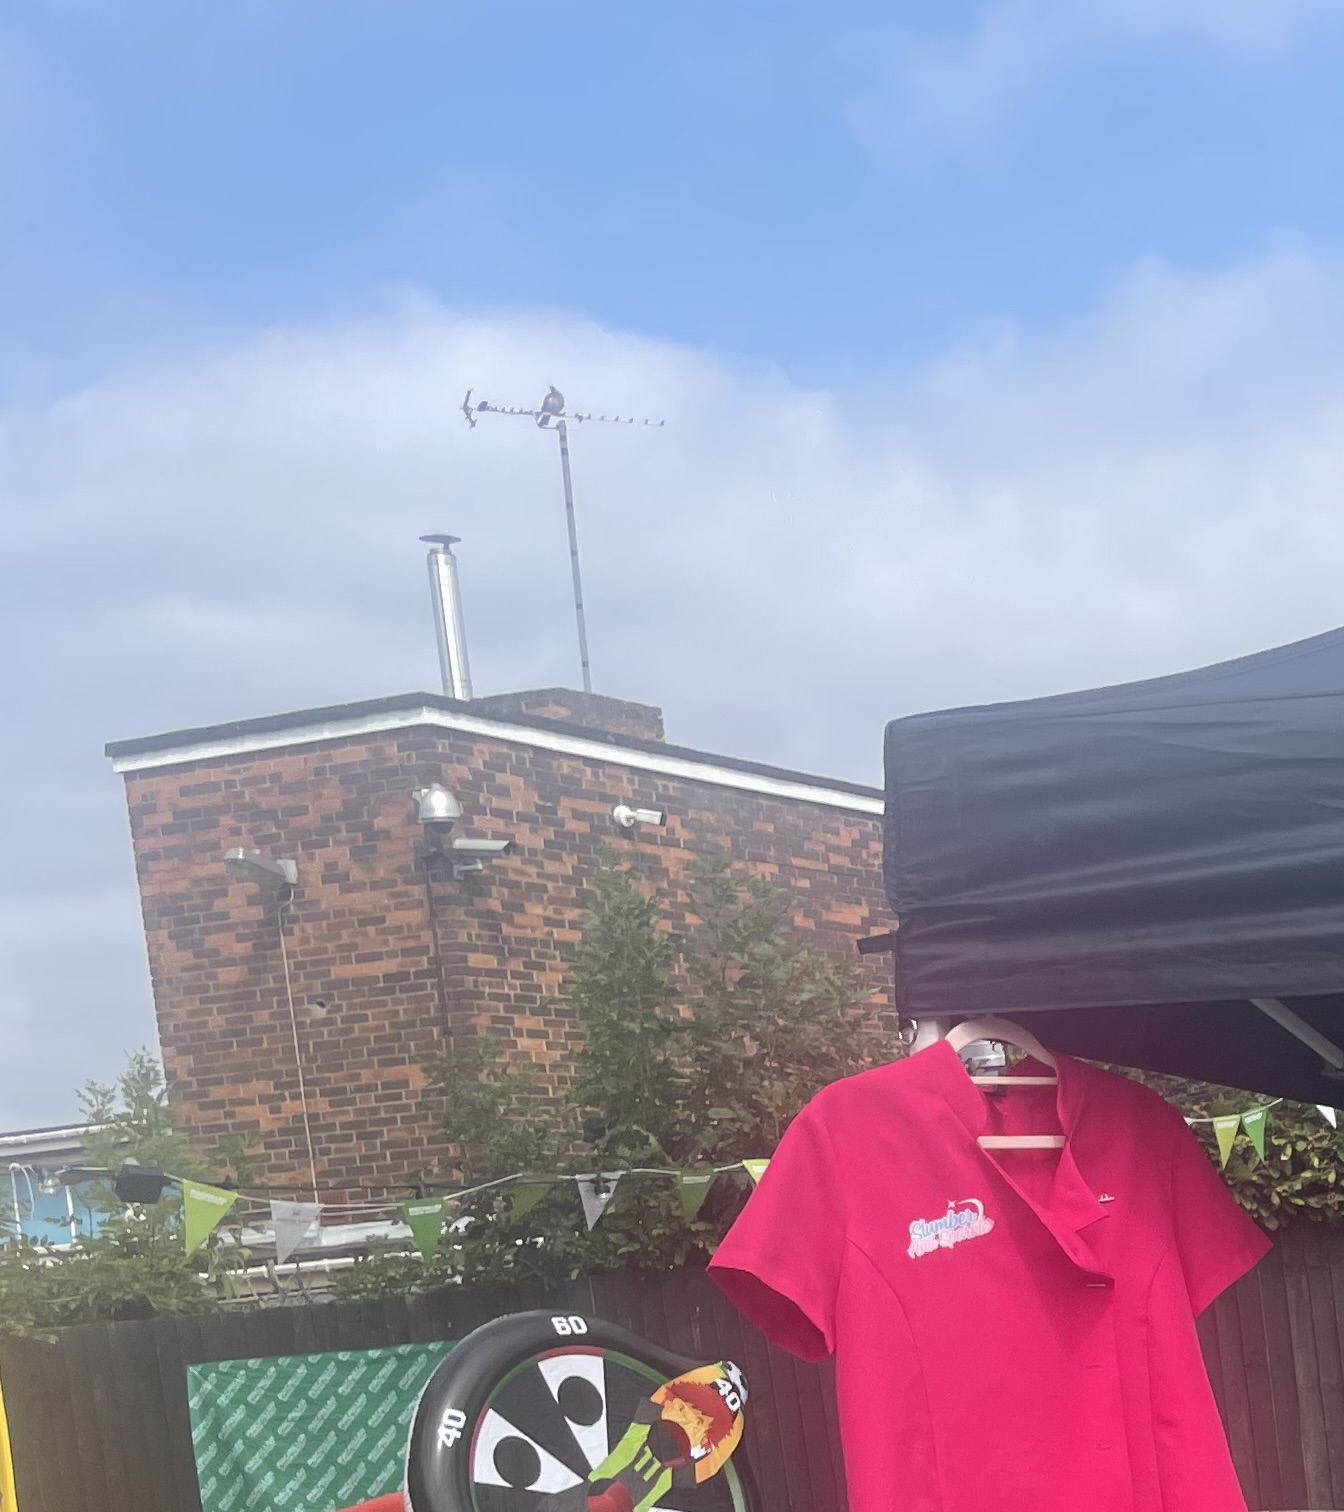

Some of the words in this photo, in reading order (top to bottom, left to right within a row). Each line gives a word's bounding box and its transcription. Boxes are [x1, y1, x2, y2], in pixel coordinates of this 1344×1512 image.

[551, 1315, 588, 1336] 60
[714, 1377, 742, 1412] 40
[437, 1407, 467, 1451] 40
